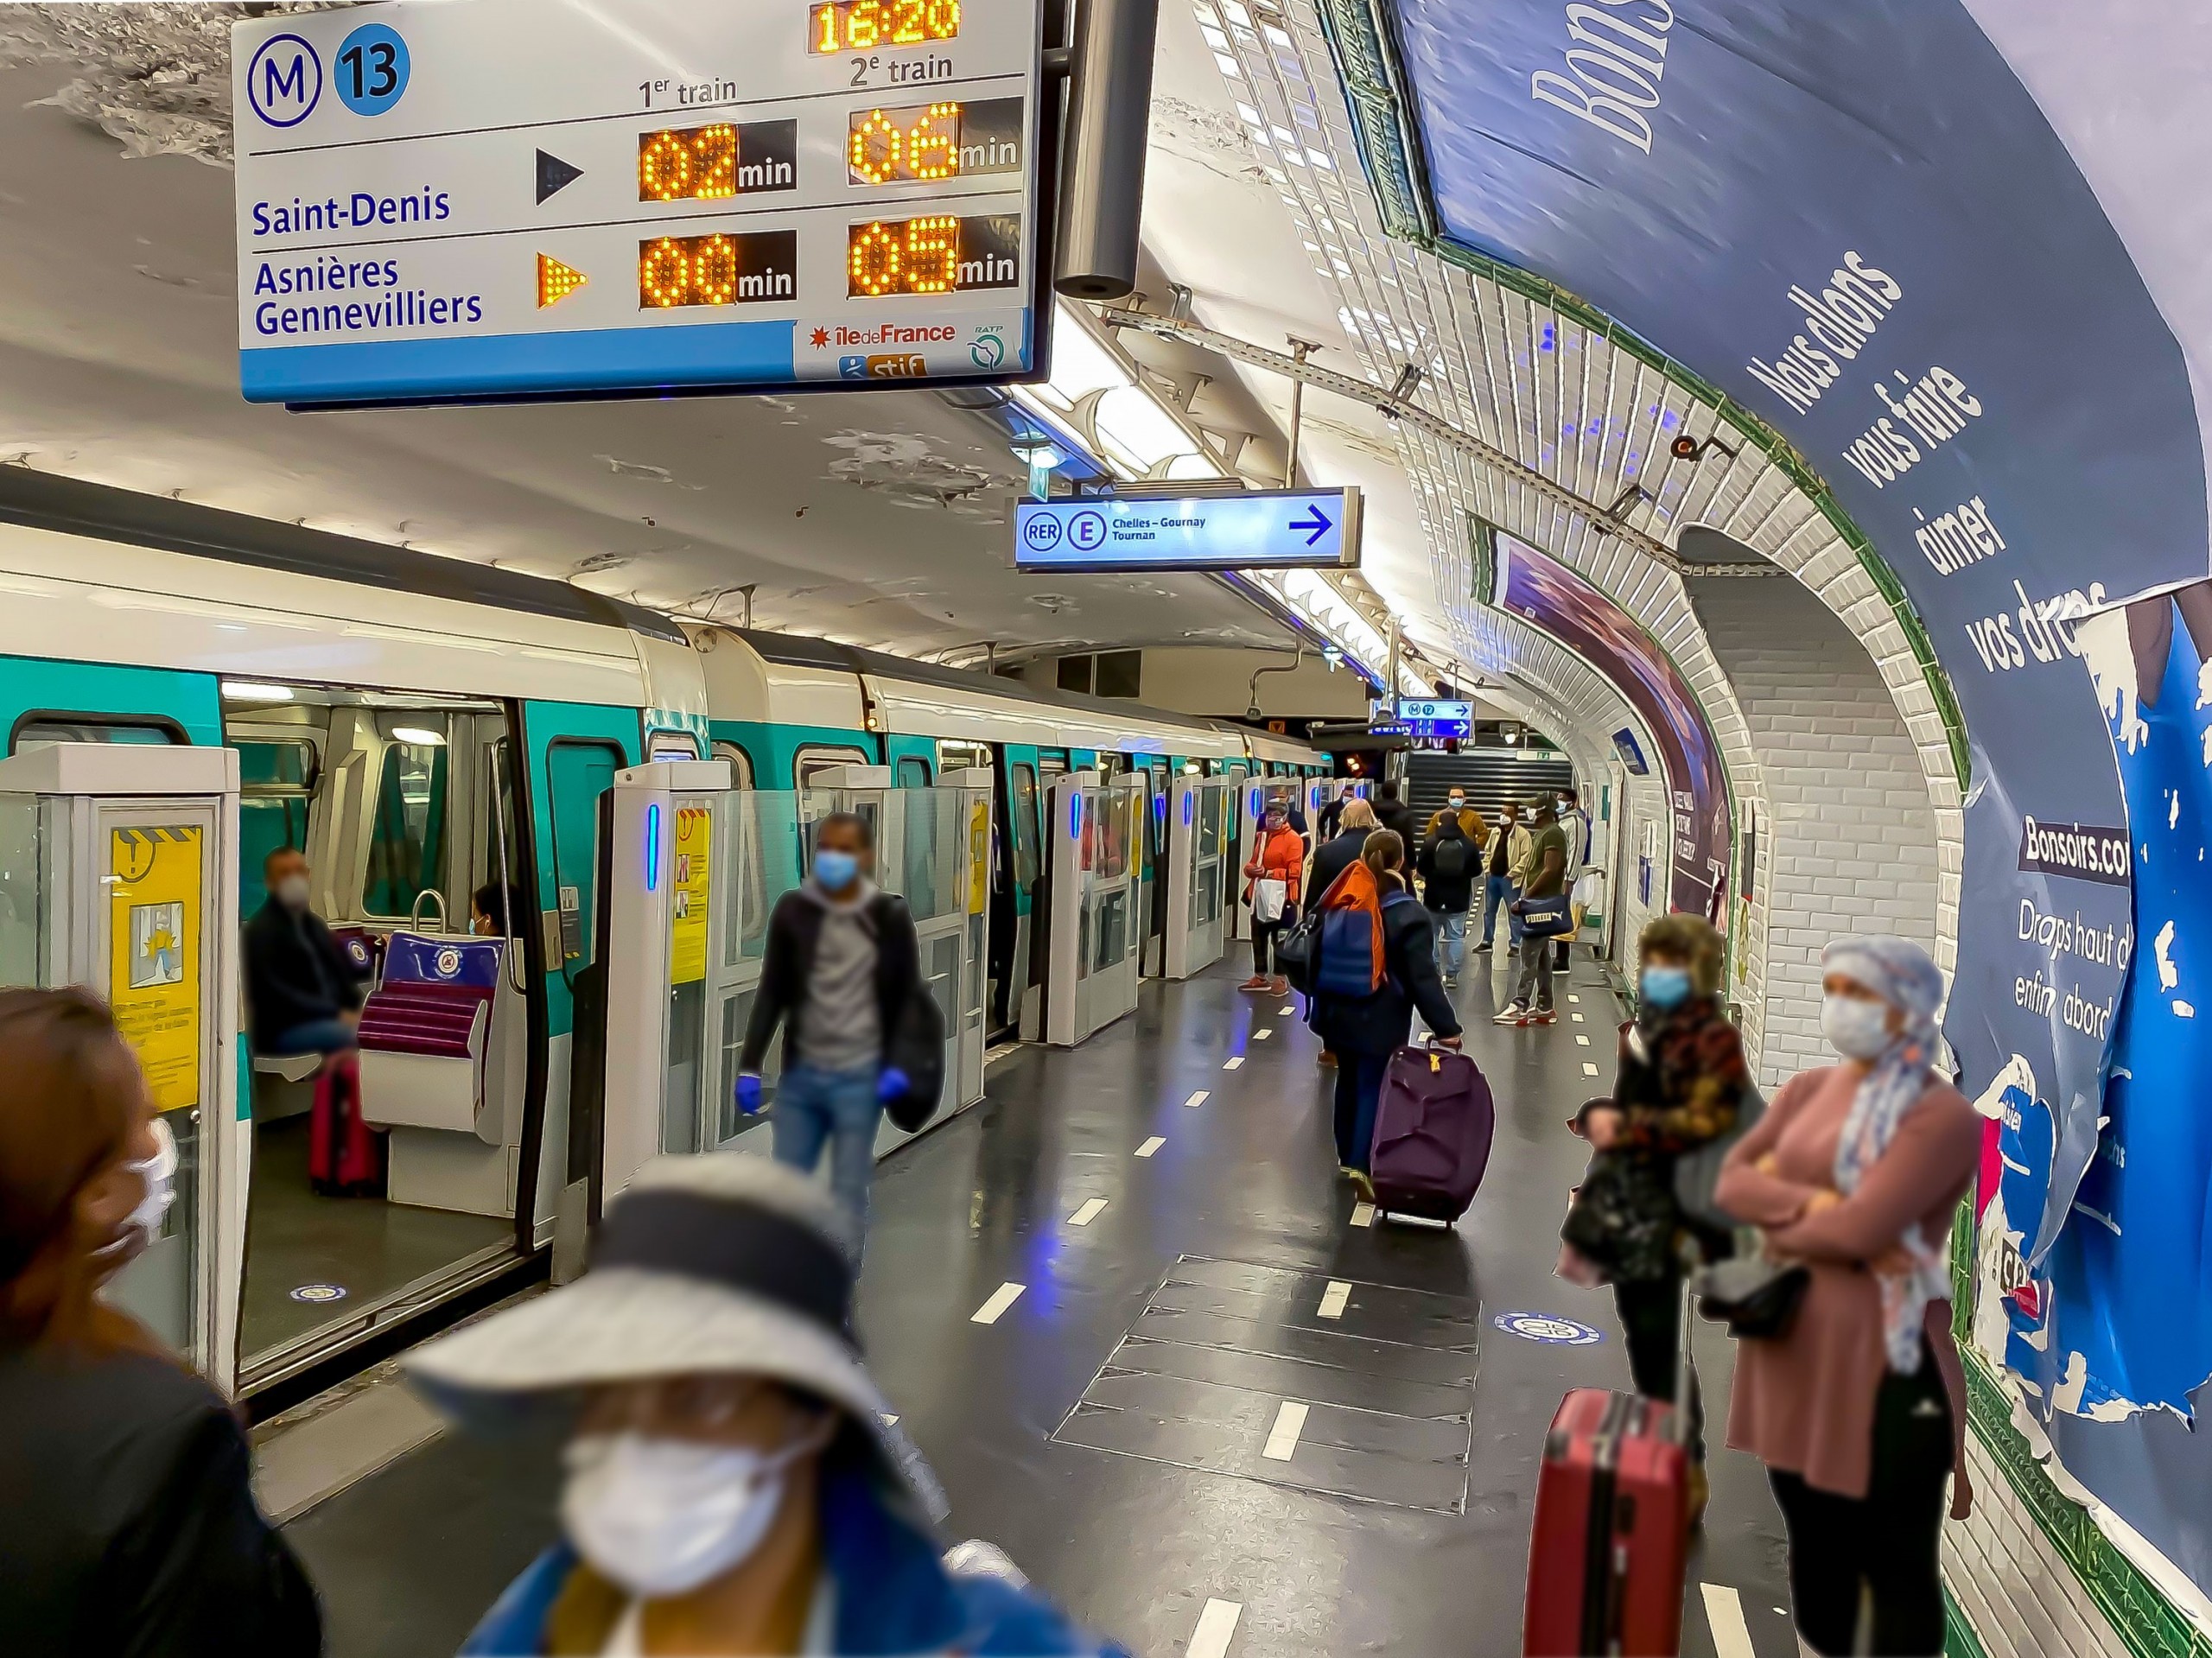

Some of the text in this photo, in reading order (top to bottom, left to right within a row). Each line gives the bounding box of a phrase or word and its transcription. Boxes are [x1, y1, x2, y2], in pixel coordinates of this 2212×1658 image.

[818, 0, 961, 53] 16:20
[264, 42, 398, 108] M 13
[677, 77, 737, 105] train
[887, 54, 953, 83] train
[852, 102, 1018, 184] 06 min
[739, 157, 792, 187] min
[252, 185, 450, 237] Saint-Denis
[254, 256, 398, 295] Asnières
[644, 234, 792, 307] 00 min
[852, 216, 1015, 296] 05 min
[255, 290, 483, 336] Gennevilliers
[975, 325, 1004, 334] RATP
[1745, 250, 1903, 416] Nous allons
[1841, 365, 1984, 490] vous faire
[1028, 521, 1094, 542] RER E
[1112, 518, 1150, 529] Chelles
[1160, 518, 1206, 529] Gournay
[1112, 530, 1155, 541] Tournan
[1912, 493, 2007, 576] aimer
[1964, 612, 2026, 673] vos
[2075, 910, 2114, 966] haut
[2014, 969, 2057, 1018] enfin
